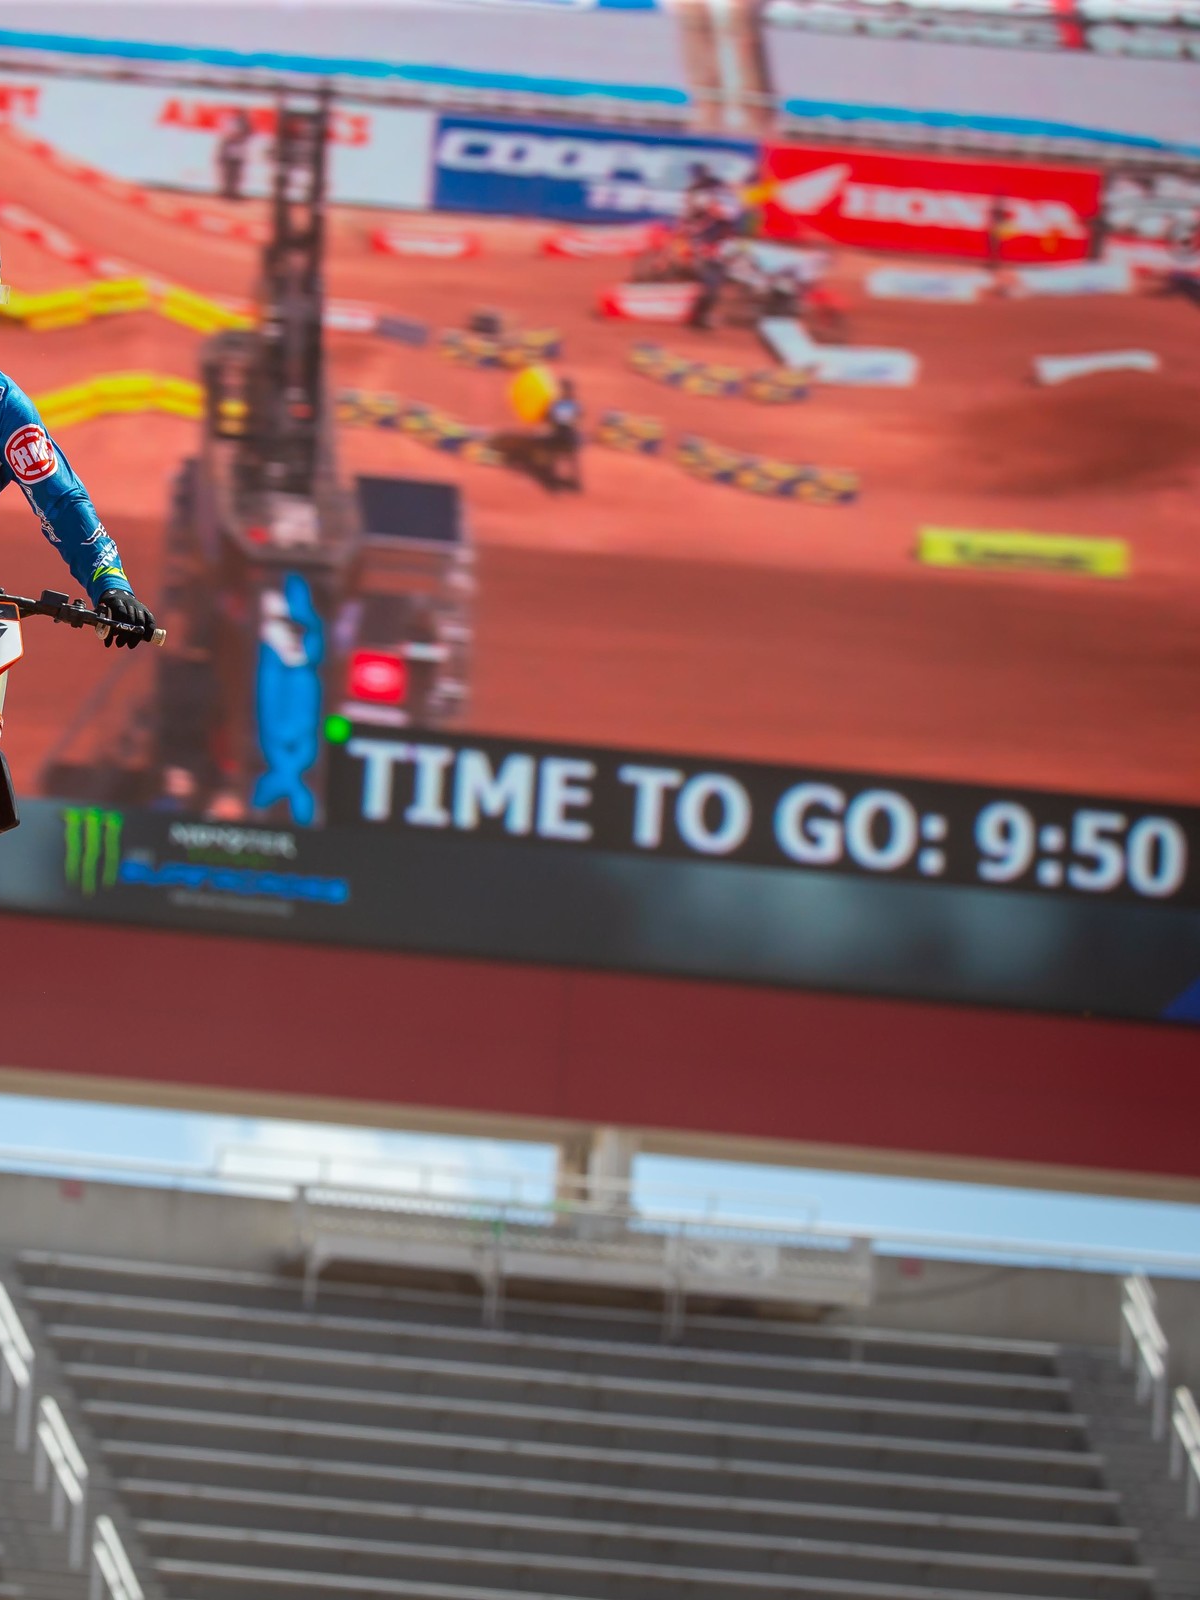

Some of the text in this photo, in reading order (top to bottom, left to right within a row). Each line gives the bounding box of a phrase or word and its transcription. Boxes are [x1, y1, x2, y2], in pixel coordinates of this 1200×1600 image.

[346, 737, 1188, 897] TIME TO GO: 9:50
